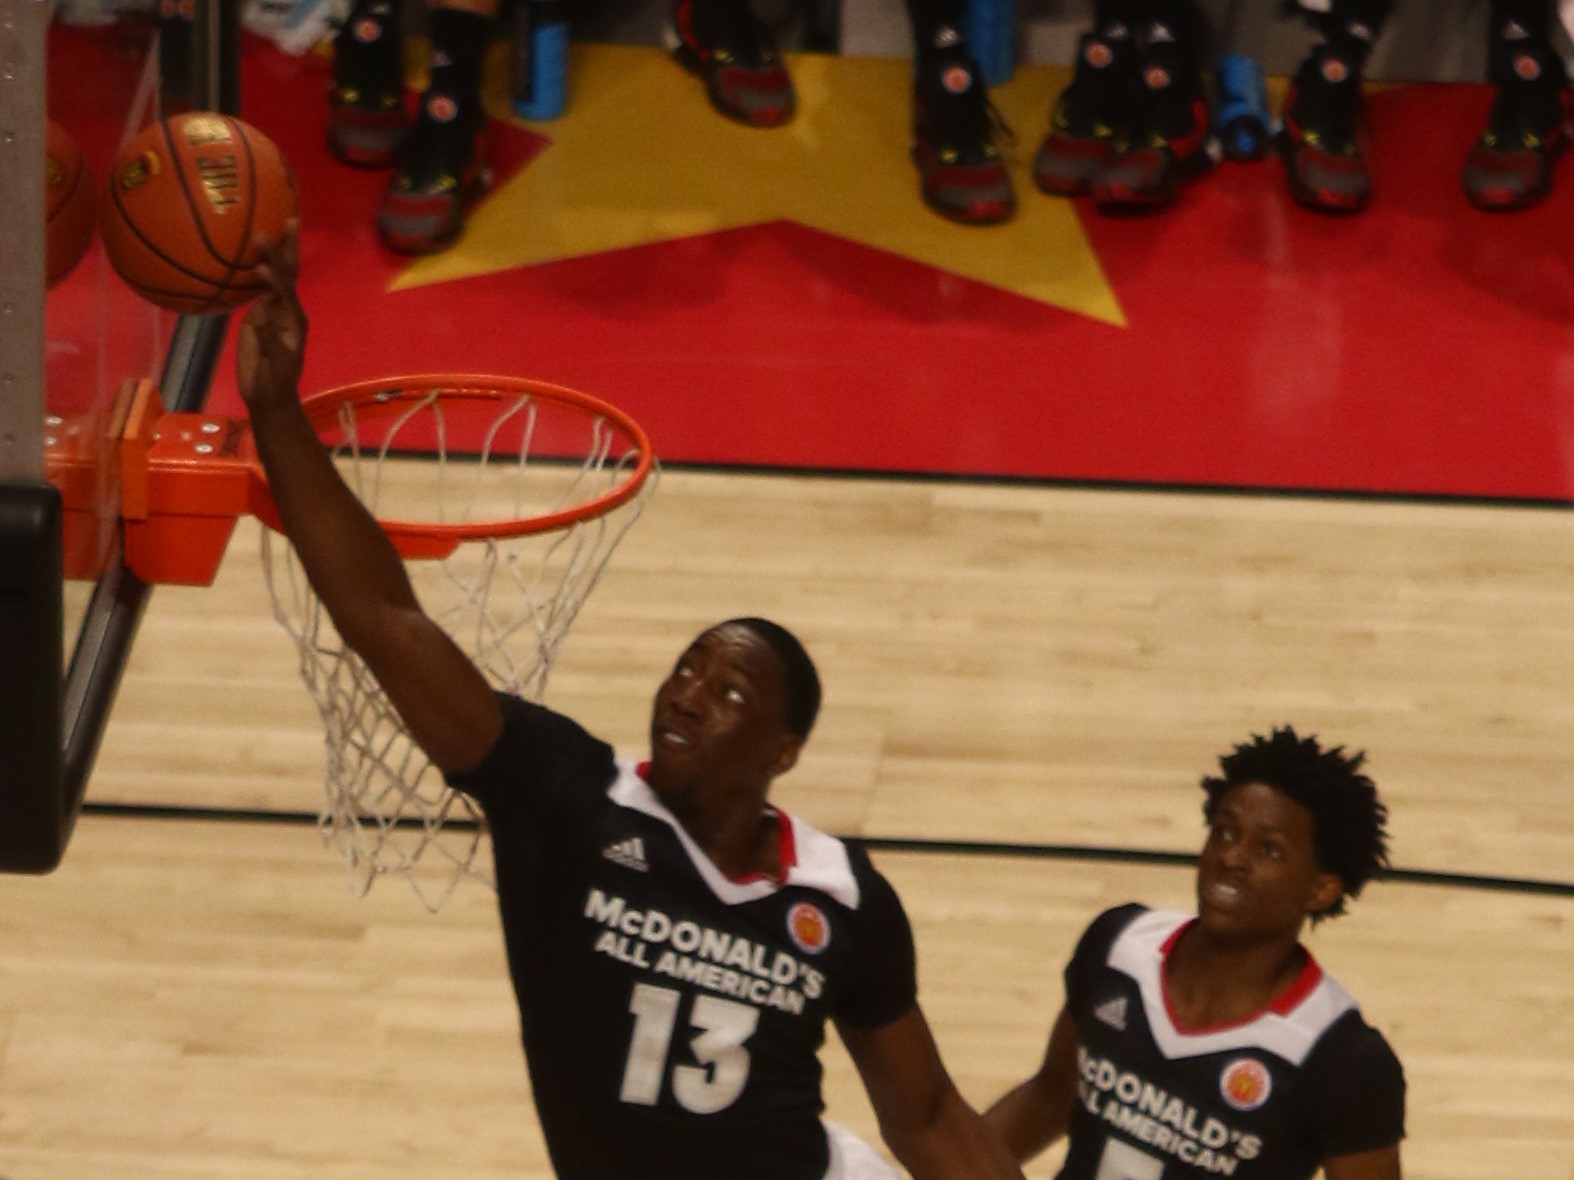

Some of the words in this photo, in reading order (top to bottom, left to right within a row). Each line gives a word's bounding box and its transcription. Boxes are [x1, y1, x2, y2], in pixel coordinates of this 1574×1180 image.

[584, 889, 826, 1000] McDONALD'S
[594, 932, 650, 969] ALL
[653, 952, 806, 1015] AMERICAN
[619, 982, 760, 1115] 13
[1102, 1099, 1241, 1176] AMERICAN
